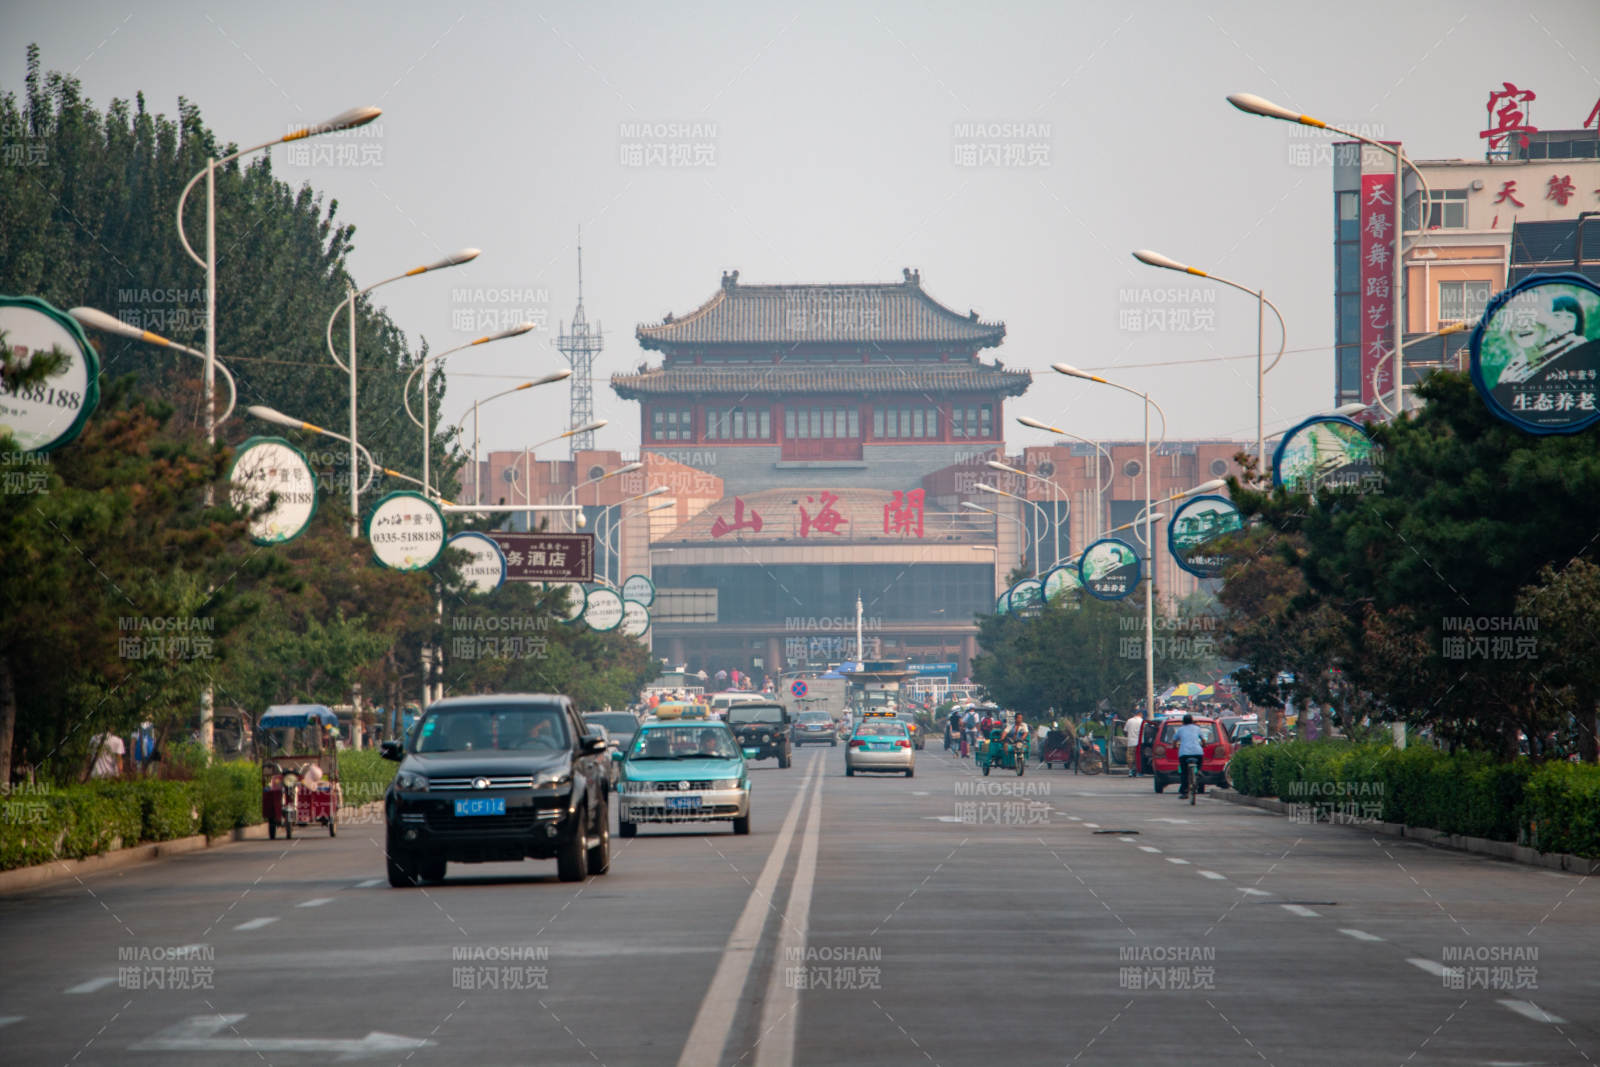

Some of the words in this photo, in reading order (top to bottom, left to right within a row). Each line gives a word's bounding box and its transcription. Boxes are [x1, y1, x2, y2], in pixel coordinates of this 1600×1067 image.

[1494, 174, 1600, 208] 天馨
[1365, 183, 1393, 423] 天馨舞蹈艺术学
[1512, 392, 1597, 412] 生态养老
[373, 531, 442, 543] 0335-5188188
[506, 550, 567, 567] 务酒店
